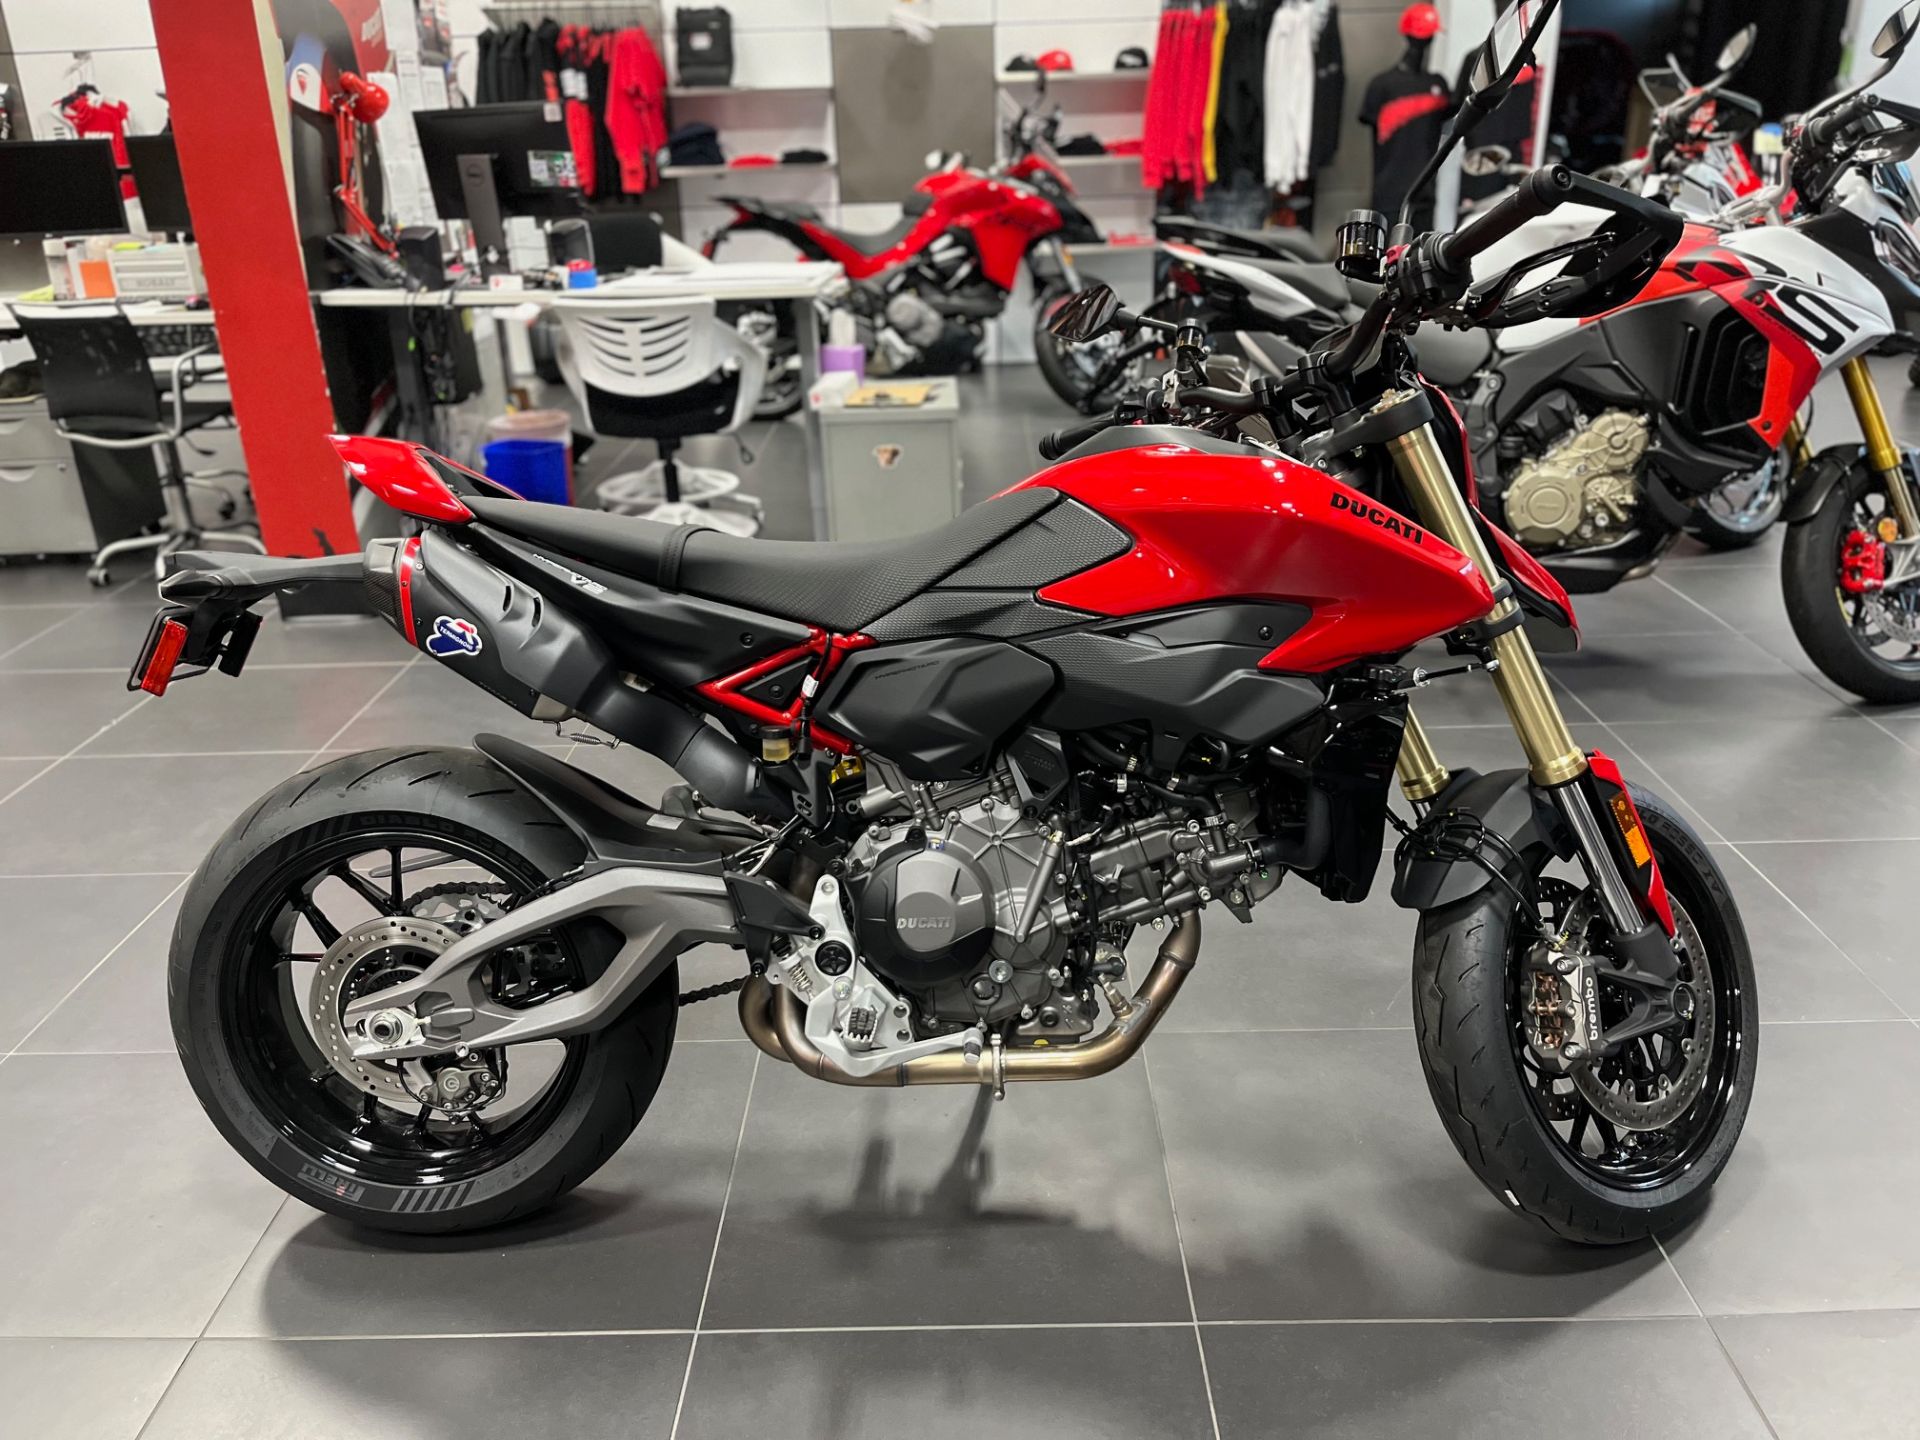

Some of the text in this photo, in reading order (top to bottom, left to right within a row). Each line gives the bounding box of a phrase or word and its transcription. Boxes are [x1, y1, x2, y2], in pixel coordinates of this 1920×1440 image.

[1330, 492, 1423, 545] DUCATI
[896, 917, 952, 930] DUCATI
[1585, 976, 1599, 1041] brembo
[297, 1162, 366, 1203] PIRELLI
